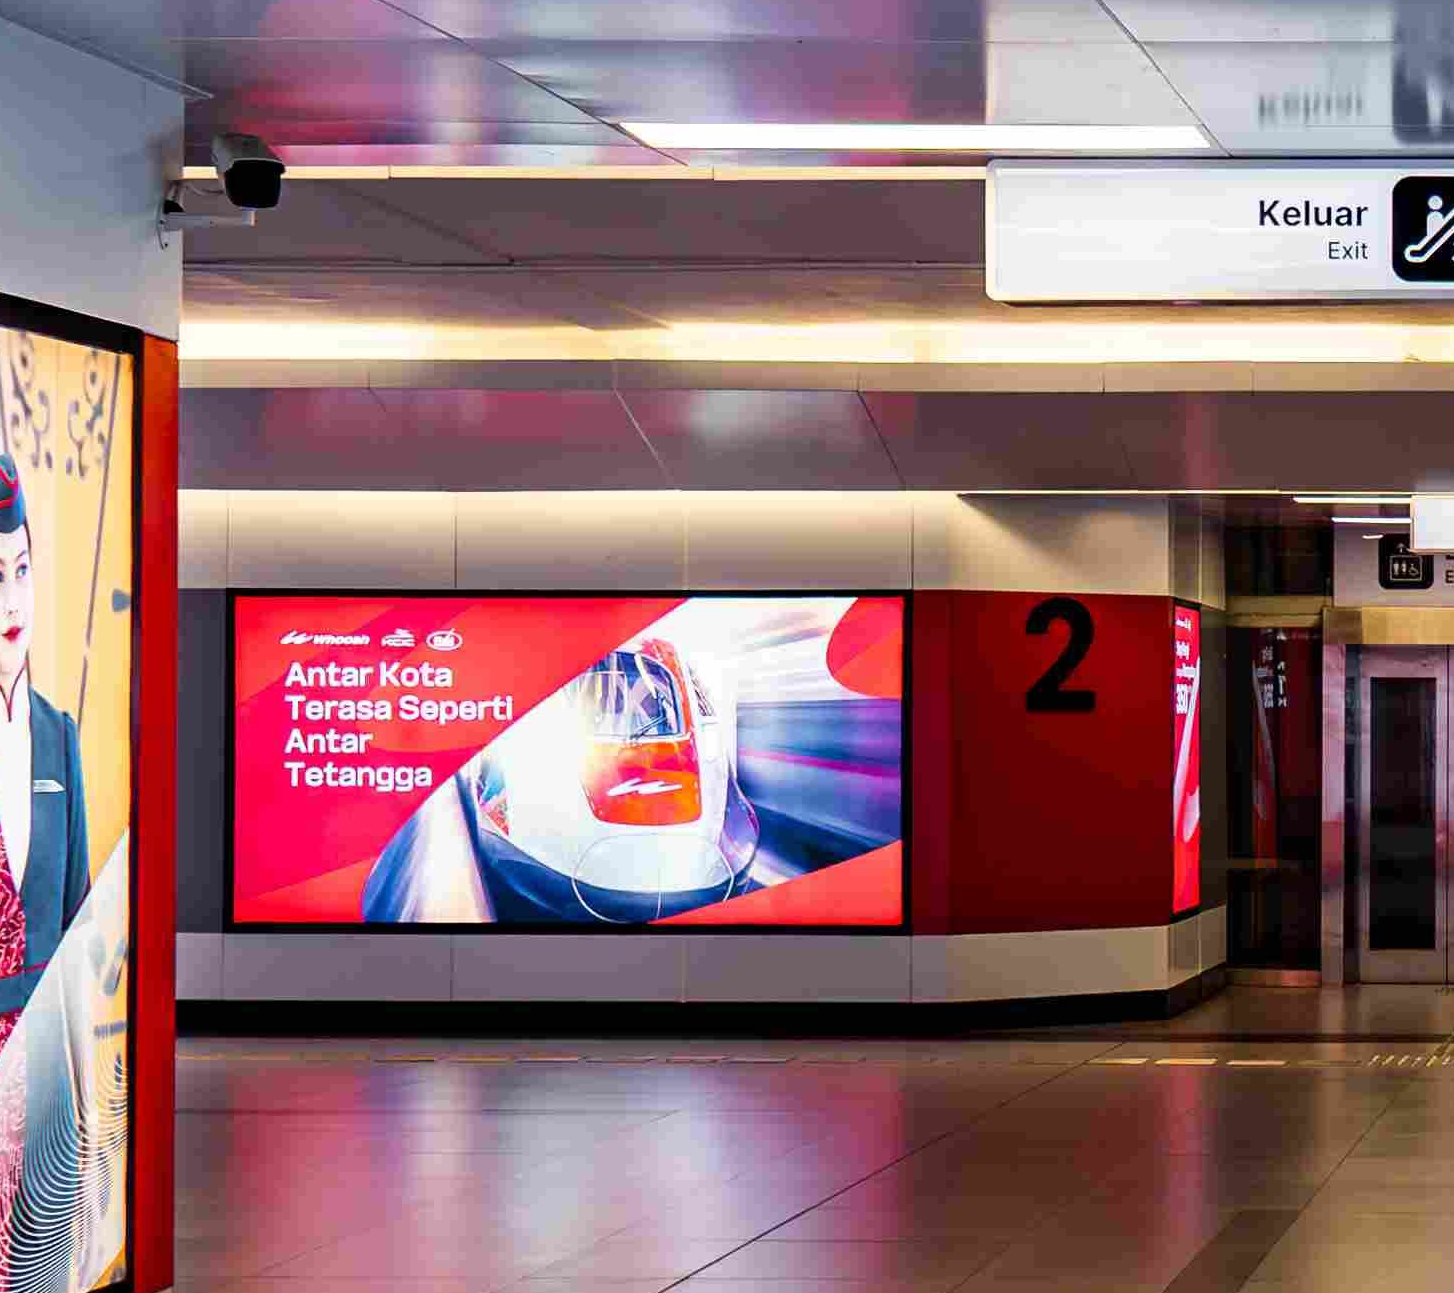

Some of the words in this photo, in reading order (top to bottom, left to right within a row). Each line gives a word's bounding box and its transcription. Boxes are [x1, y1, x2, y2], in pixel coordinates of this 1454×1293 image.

[1259, 200, 1368, 227] Keluar
[1328, 241, 1368, 260] Exit
[1025, 597, 1095, 712] 2
[284, 662, 373, 687] Antar
[379, 662, 452, 687] Kota
[284, 695, 392, 721] Terasa
[398, 694, 513, 725] Seperti
[284, 728, 373, 754] Antar
[284, 761, 433, 792] Tetangga
